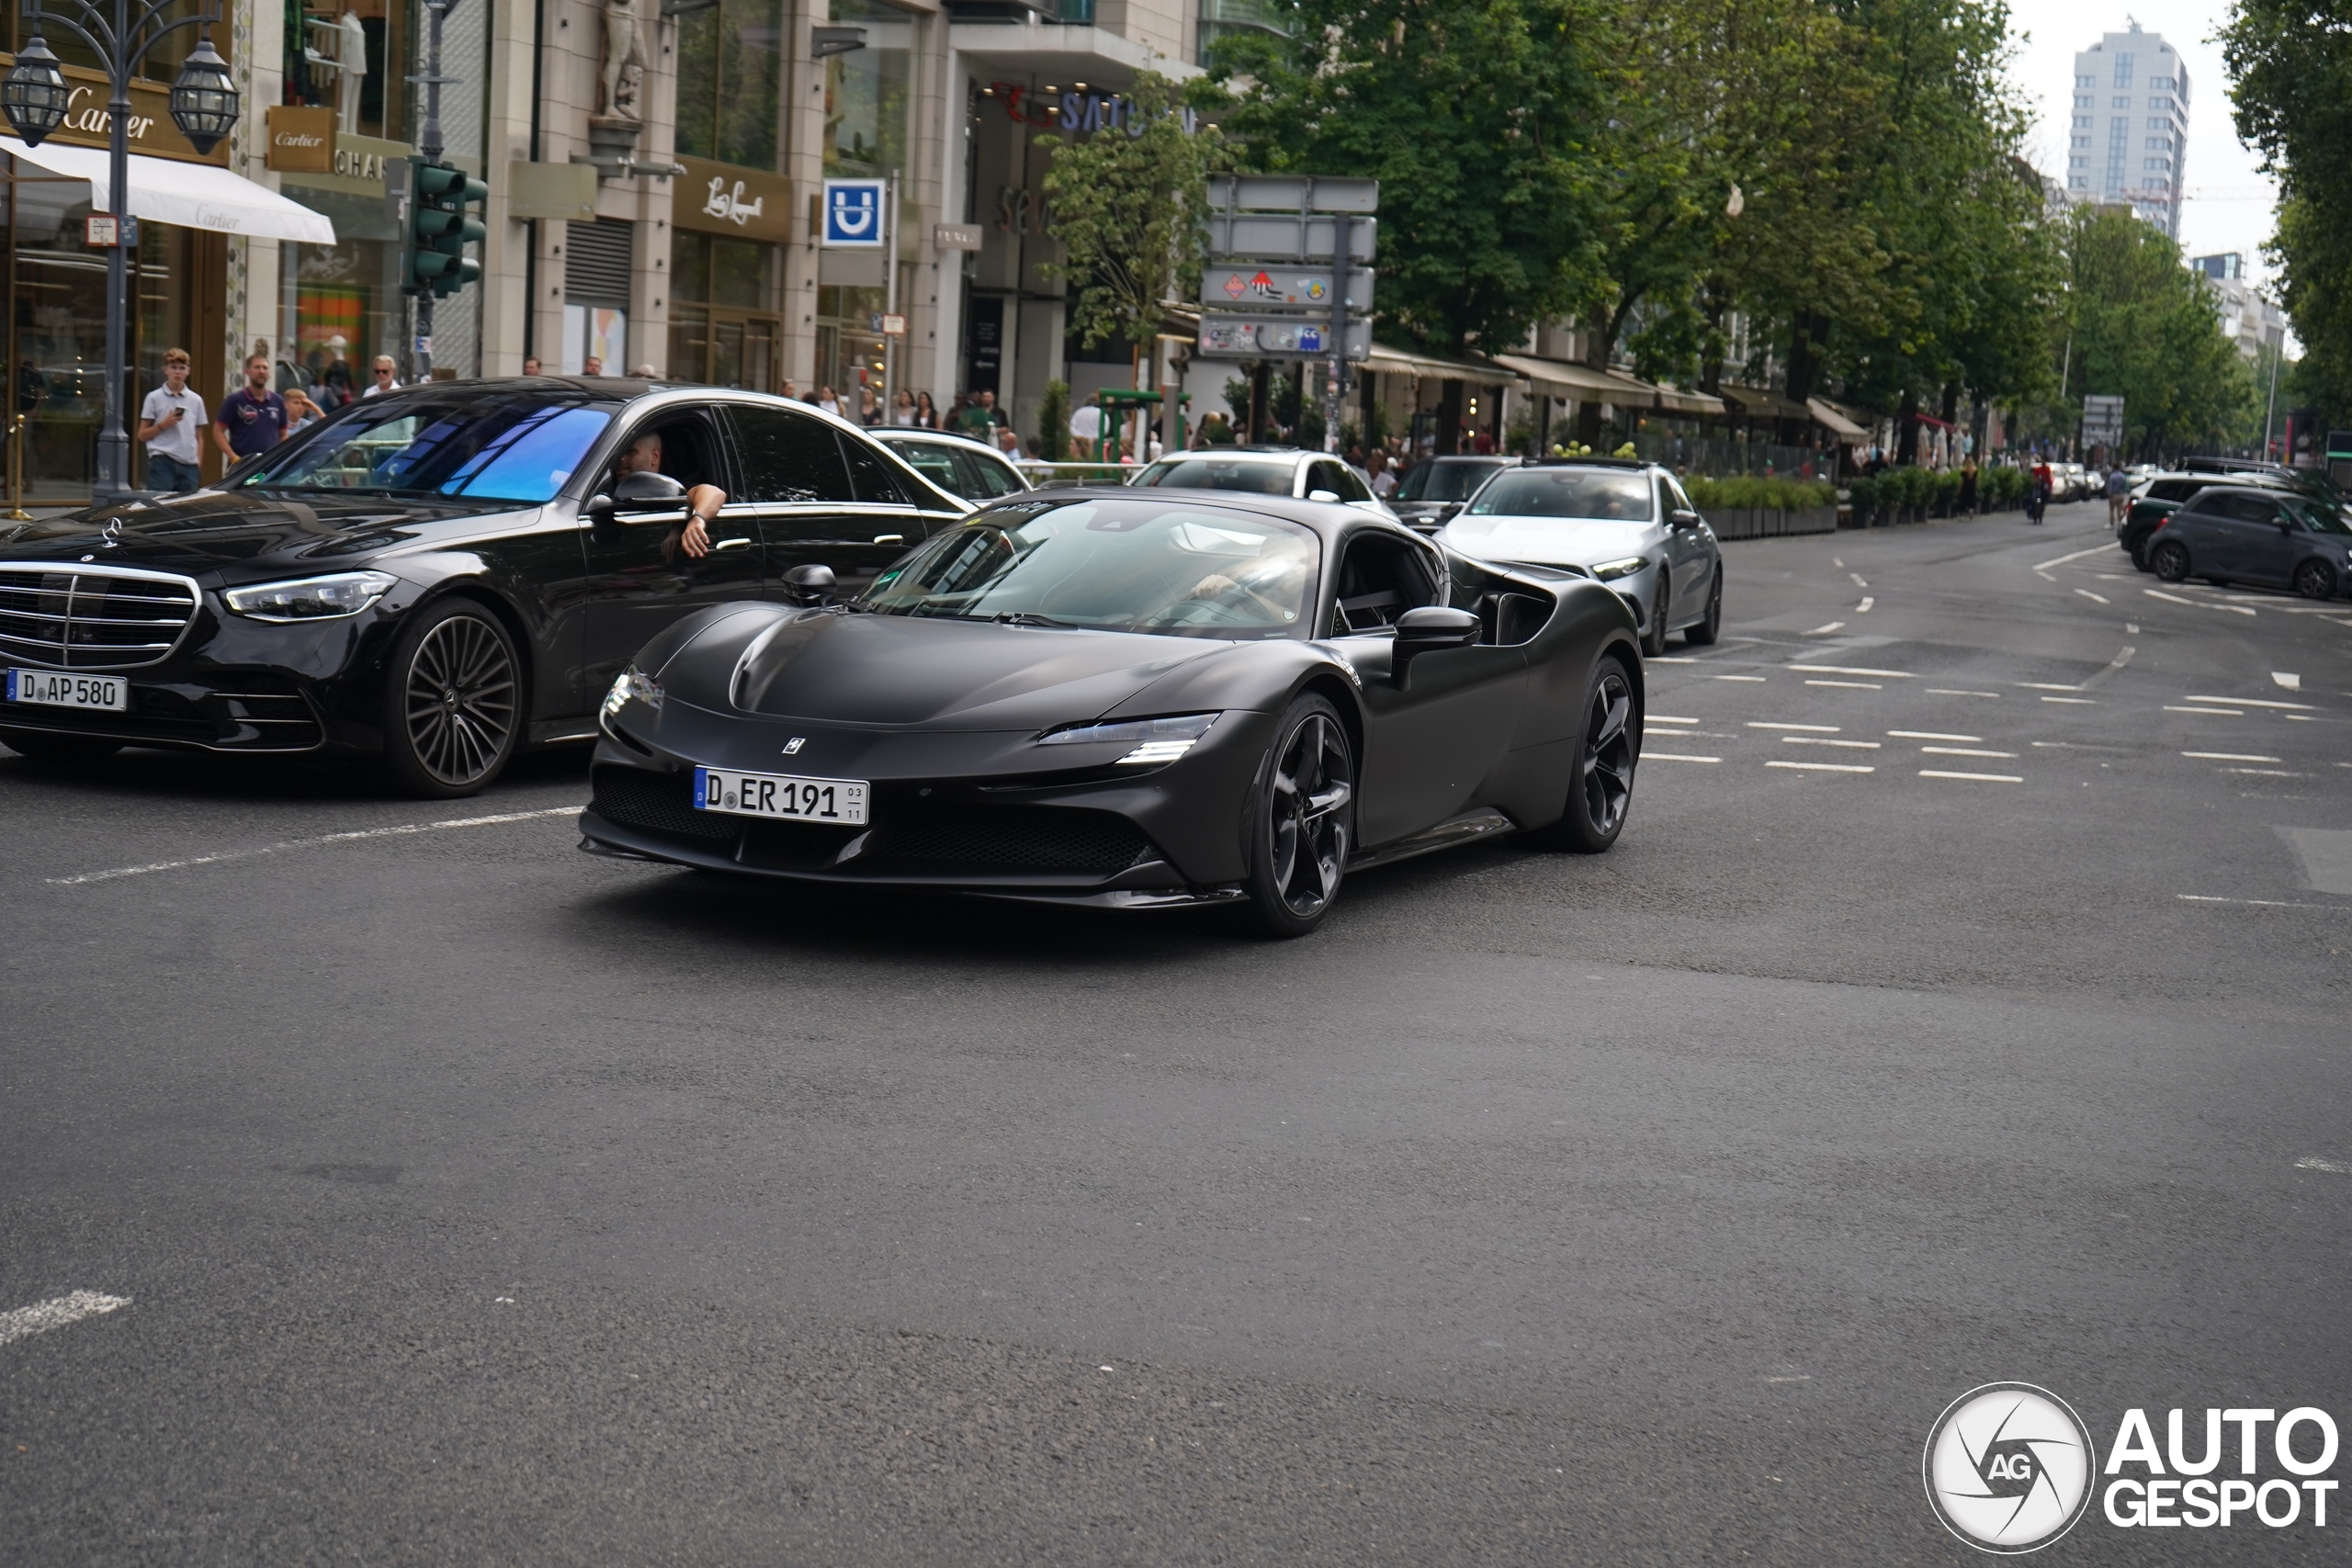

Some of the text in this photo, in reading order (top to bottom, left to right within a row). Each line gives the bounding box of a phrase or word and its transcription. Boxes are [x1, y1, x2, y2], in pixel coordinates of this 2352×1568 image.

[63, 86, 153, 139] Carer
[1060, 93, 1196, 136] SATUN
[275, 131, 323, 147] Cartier
[196, 202, 241, 229] Cartier
[835, 191, 872, 234] U
[24, 674, 116, 705] D AP 580
[707, 774, 838, 818] D ER 191
[848, 787, 862, 796] 03
[848, 809, 860, 818] 11
